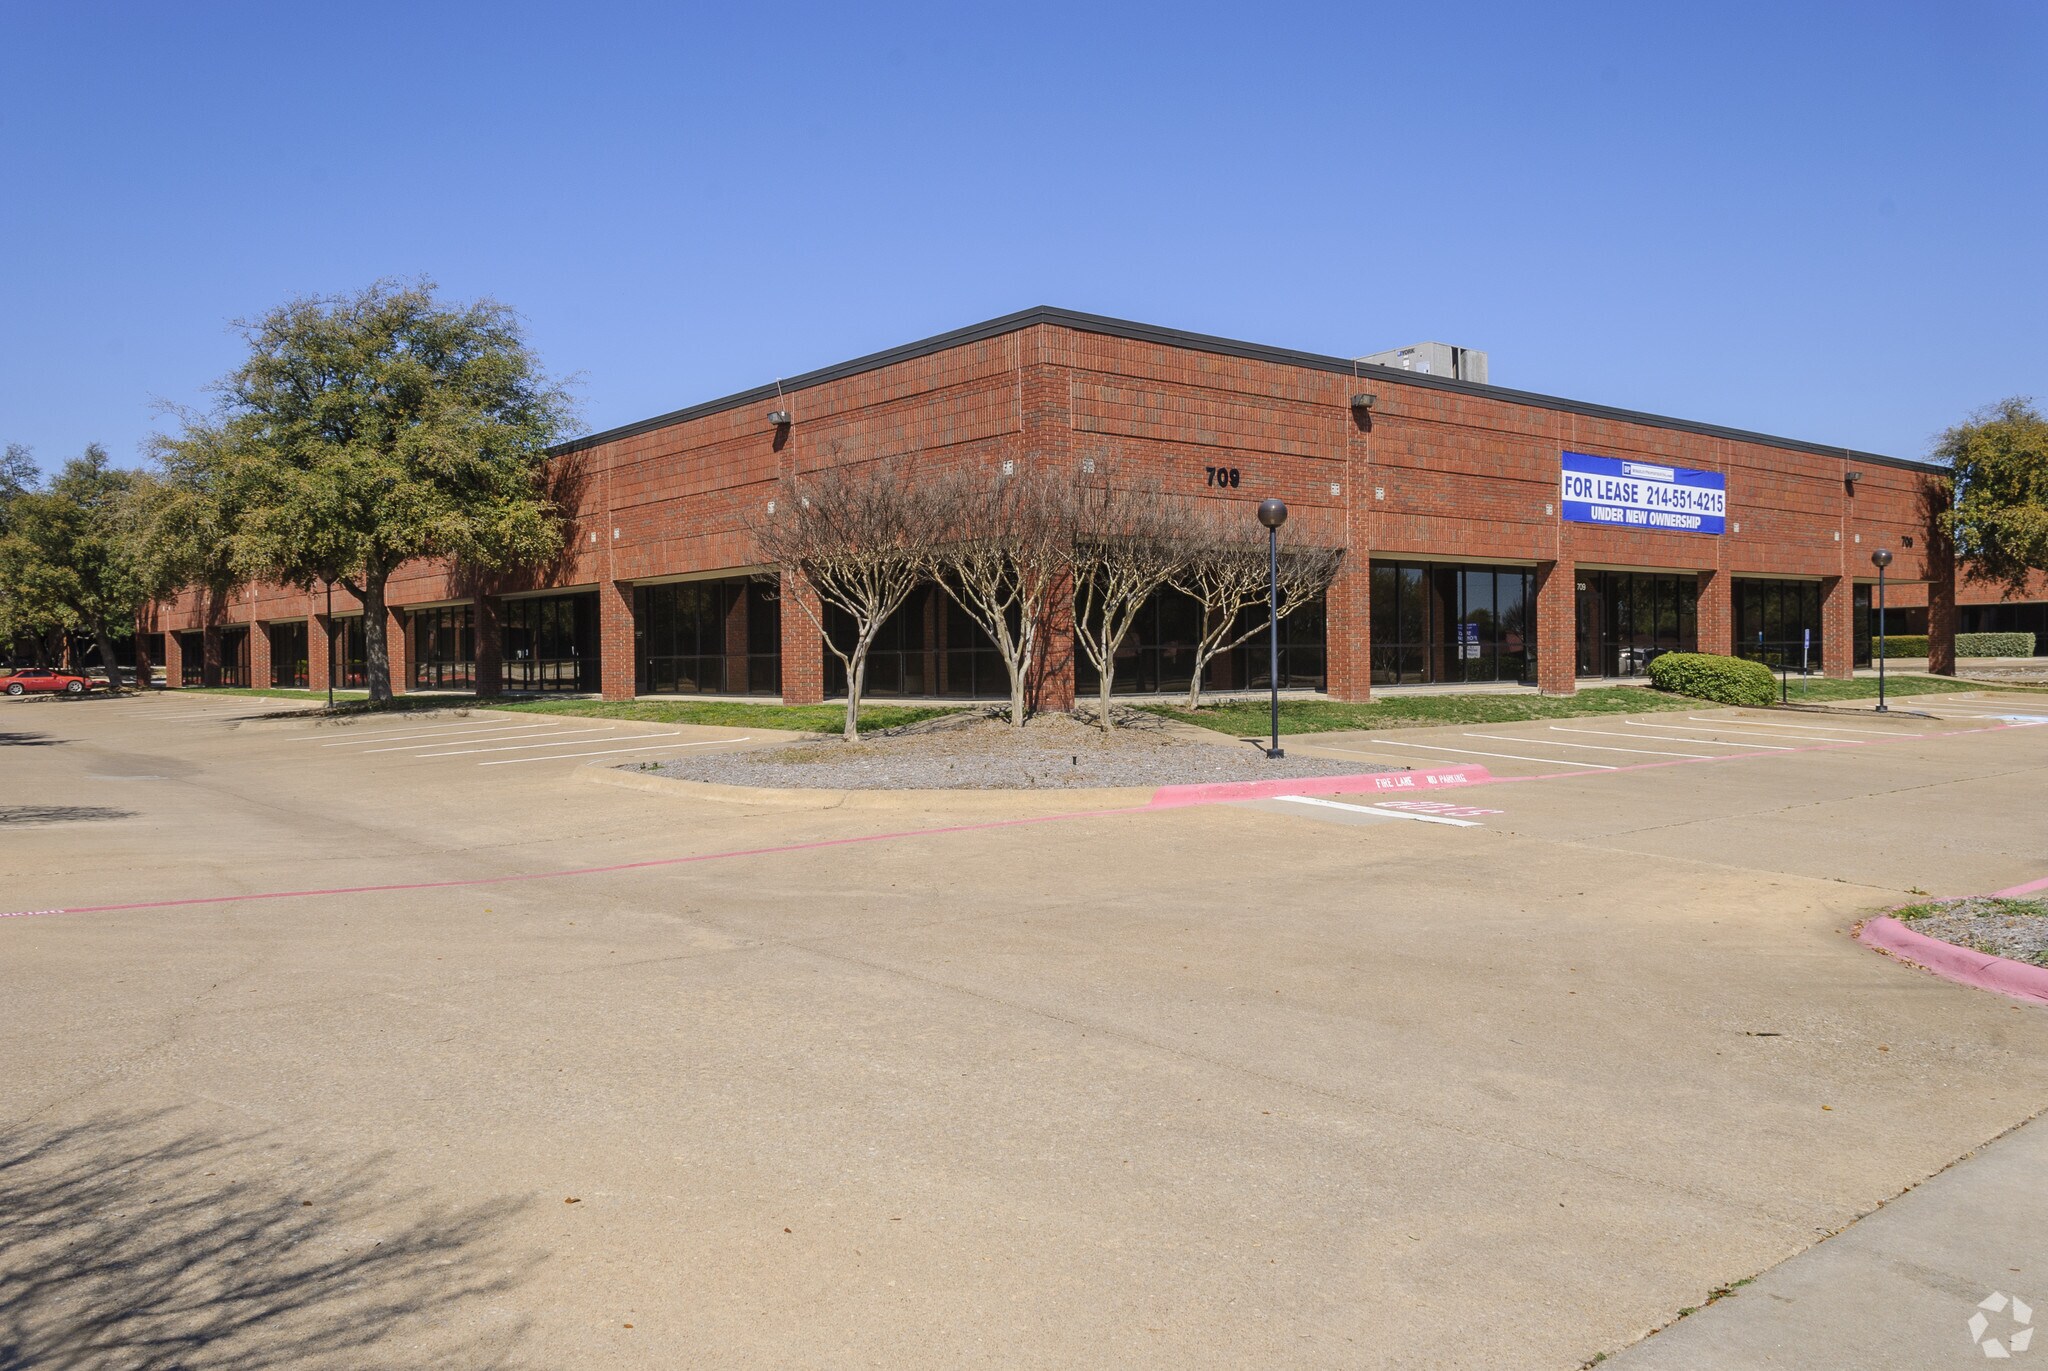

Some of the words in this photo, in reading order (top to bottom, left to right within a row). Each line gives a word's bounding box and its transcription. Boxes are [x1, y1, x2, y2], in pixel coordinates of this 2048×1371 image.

[1205, 466, 1240, 489] 709
[1565, 476, 1592, 498] FOR
[1597, 480, 1638, 503] LEASE
[1647, 486, 1723, 513] 214-551-4215
[1591, 506, 1624, 522] UNDER
[1626, 510, 1647, 524] NEW
[1649, 512, 1701, 529] OWNERSHIP
[1375, 778, 1393, 788] FIRE
[1395, 776, 1415, 787] LANE
[1426, 775, 1438, 784] NO
[1438, 773, 1467, 783] PARKING
